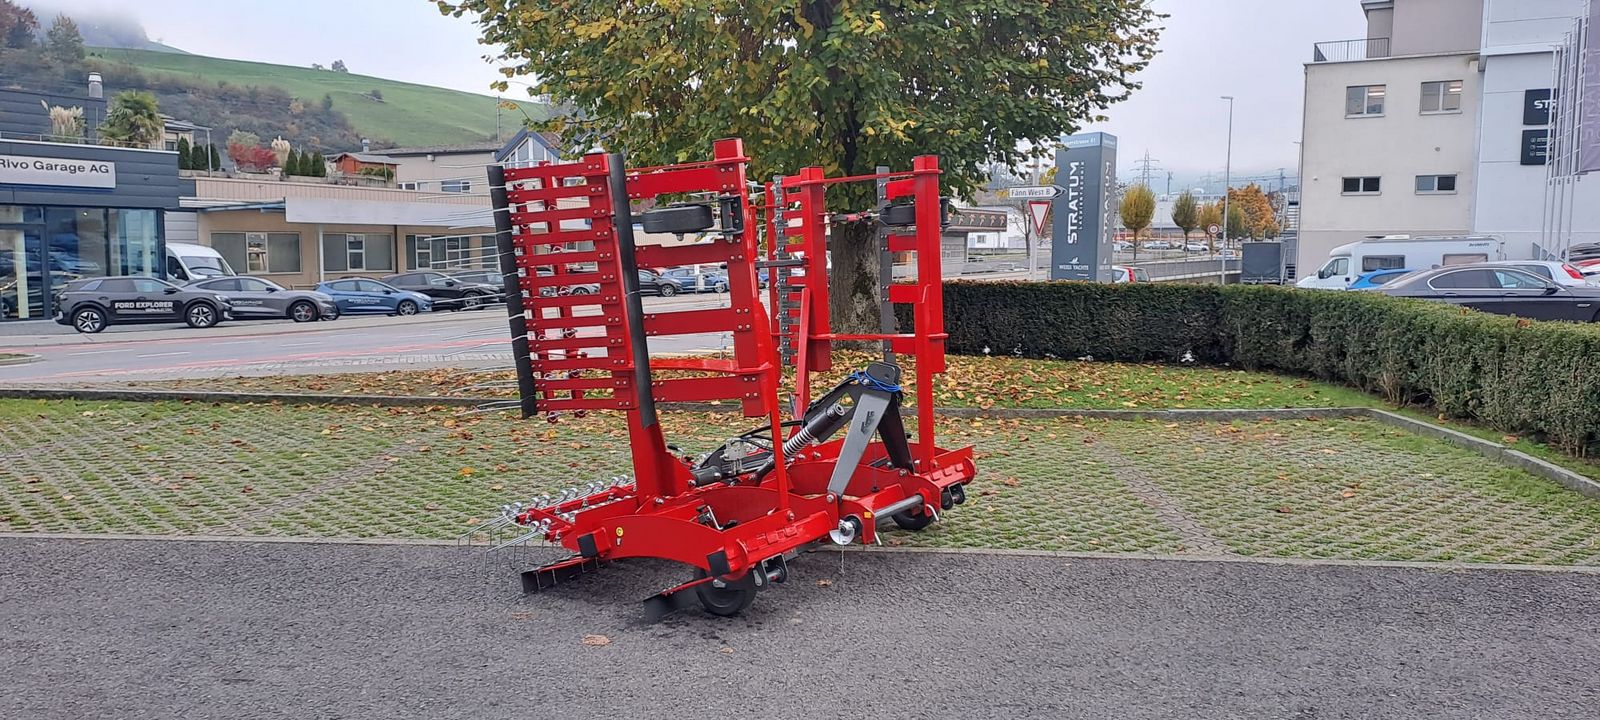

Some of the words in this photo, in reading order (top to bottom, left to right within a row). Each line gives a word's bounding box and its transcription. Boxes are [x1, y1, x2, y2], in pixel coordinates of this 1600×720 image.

[0, 158, 29, 170] Rivo
[33, 160, 86, 174] Garage
[89, 164, 110, 174] AG
[1011, 188, 1027, 197] Fänn
[1028, 188, 1044, 196] West
[1067, 161, 1080, 244] STRATUM
[135, 301, 174, 309] EXPLORER
